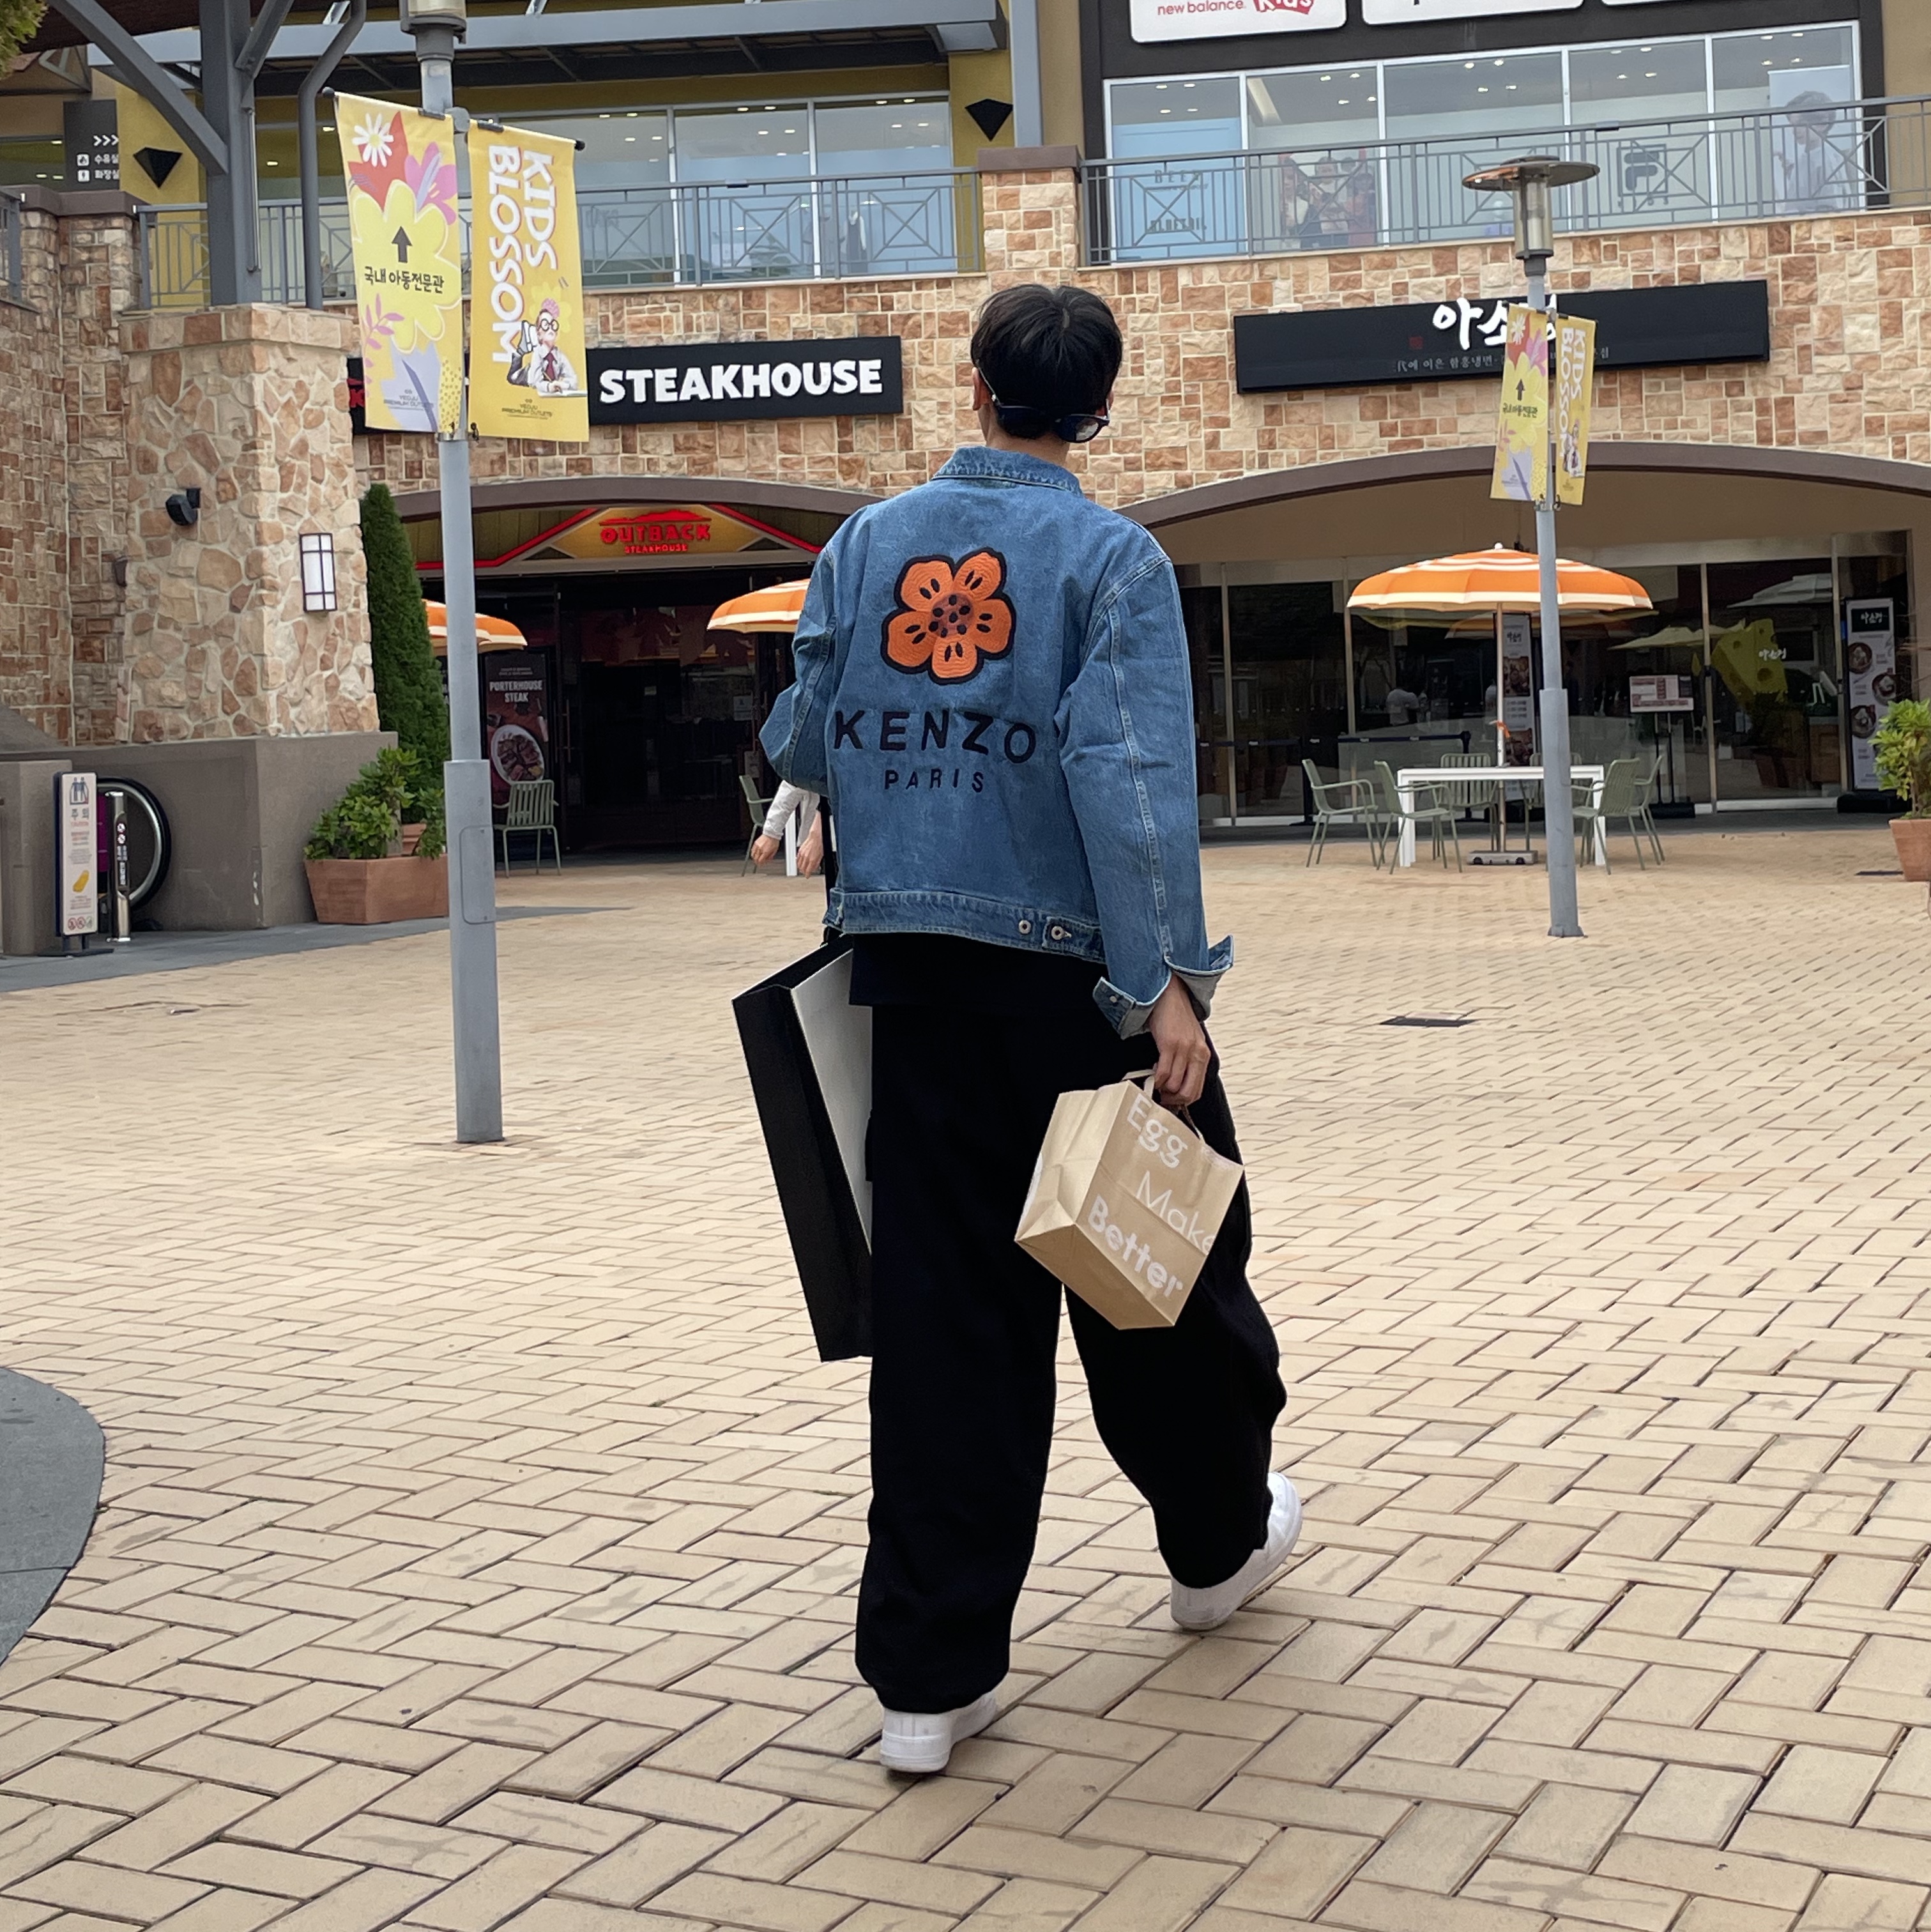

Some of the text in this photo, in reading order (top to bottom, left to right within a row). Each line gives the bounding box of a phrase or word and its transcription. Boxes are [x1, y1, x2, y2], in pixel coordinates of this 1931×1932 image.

[1157, 4, 1185, 15] new
[1187, 0, 1243, 13] balance
[523, 150, 558, 270] KIDS
[488, 144, 524, 363] BLOSSOM
[365, 266, 445, 294] 국내 아동전문관
[1432, 294, 1556, 350] 아소
[599, 359, 883, 403] STEAKHOUSE
[1570, 328, 1586, 399] KIDS
[600, 524, 711, 544] OUTBACK
[625, 544, 688, 554] STEAKHOUSE
[489, 680, 542, 691] PORTERHOUSE
[505, 692, 529, 703] STEAK
[834, 709, 1036, 763] KENZO
[884, 769, 984, 793] PARIS
[1127, 1092, 1188, 1169] Egg
[1135, 1170, 1215, 1252] Make
[1088, 1195, 1184, 1298] Better
